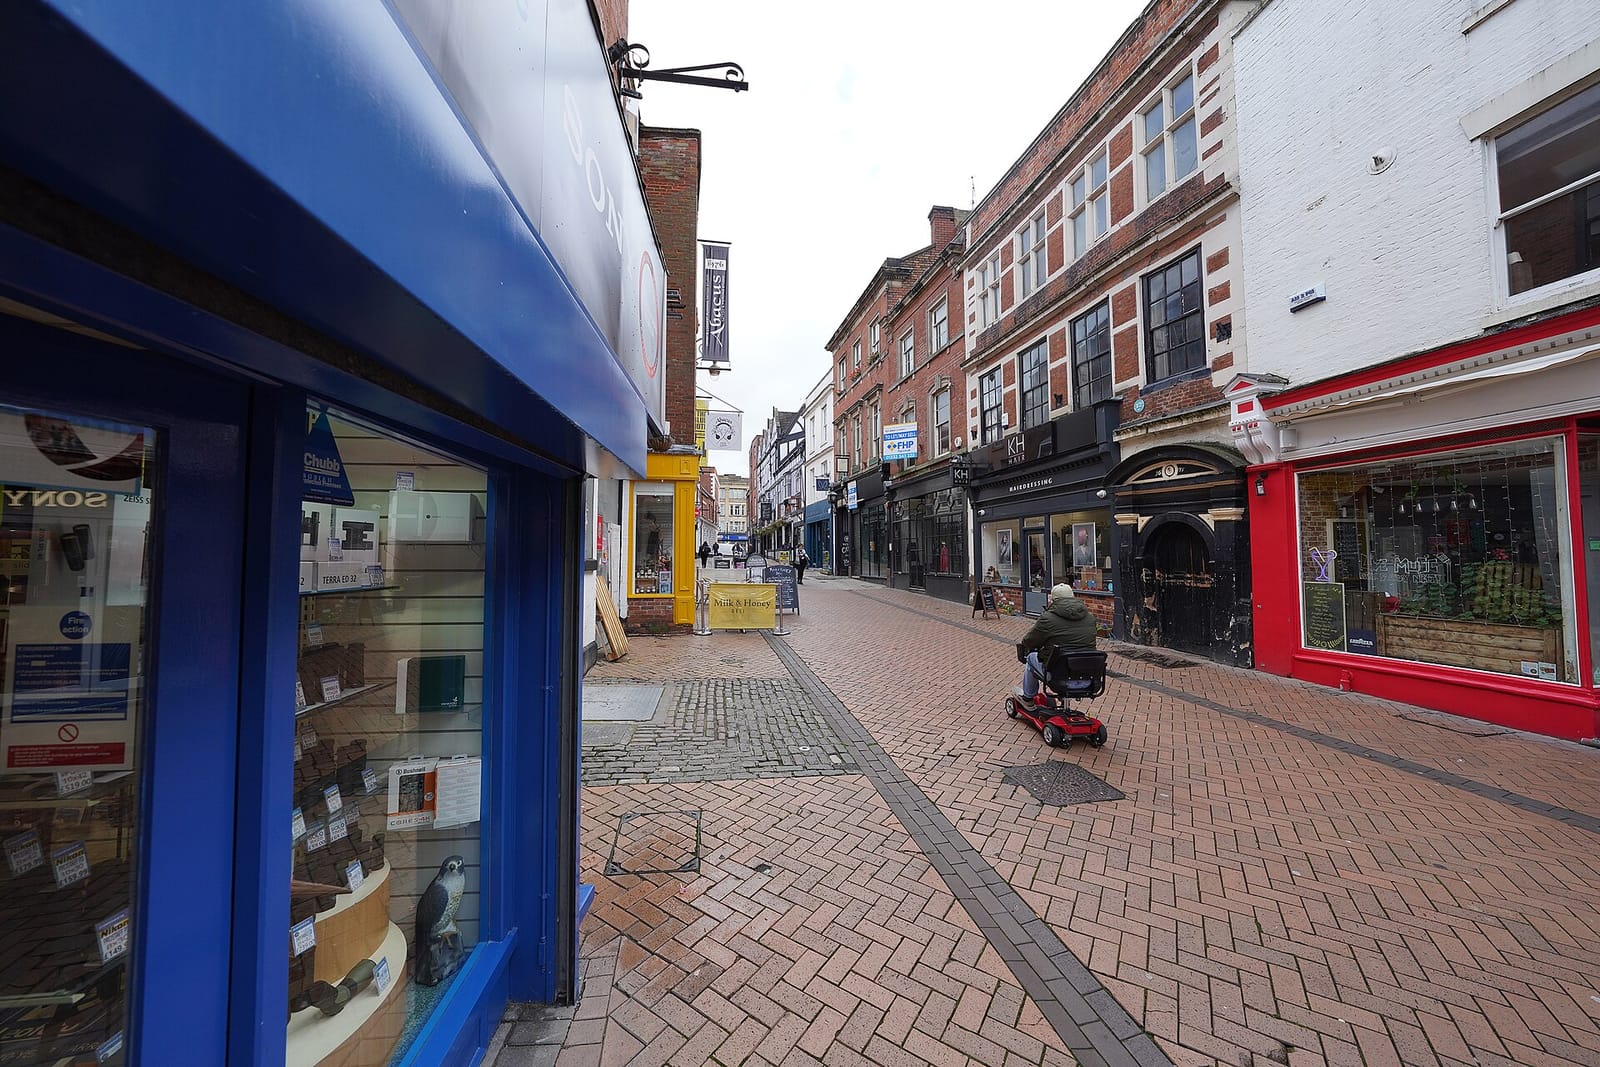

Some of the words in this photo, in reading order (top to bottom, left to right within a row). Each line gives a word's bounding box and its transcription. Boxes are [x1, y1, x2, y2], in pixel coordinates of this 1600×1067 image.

[709, 275, 725, 348] Abacus
[897, 441, 914, 449] FHP
[1007, 434, 1025, 456] KH
[304, 452, 340, 471] Chubb
[1008, 455, 1025, 465] HAIR
[954, 469, 968, 479] KH
[1009, 477, 1053, 492] HAIRDRESSING
[123, 494, 144, 504] ZEISS
[322, 576, 341, 585] TERRA
[350, 574, 357, 583] 32
[714, 599, 734, 607] Milk
[744, 599, 771, 609] Honey
[403, 767, 426, 775] Bushnell
[391, 818, 413, 826] CORE
[55, 849, 85, 865] Nikon
[59, 870, 88, 886] £159.99
[101, 919, 129, 938] Nikon
